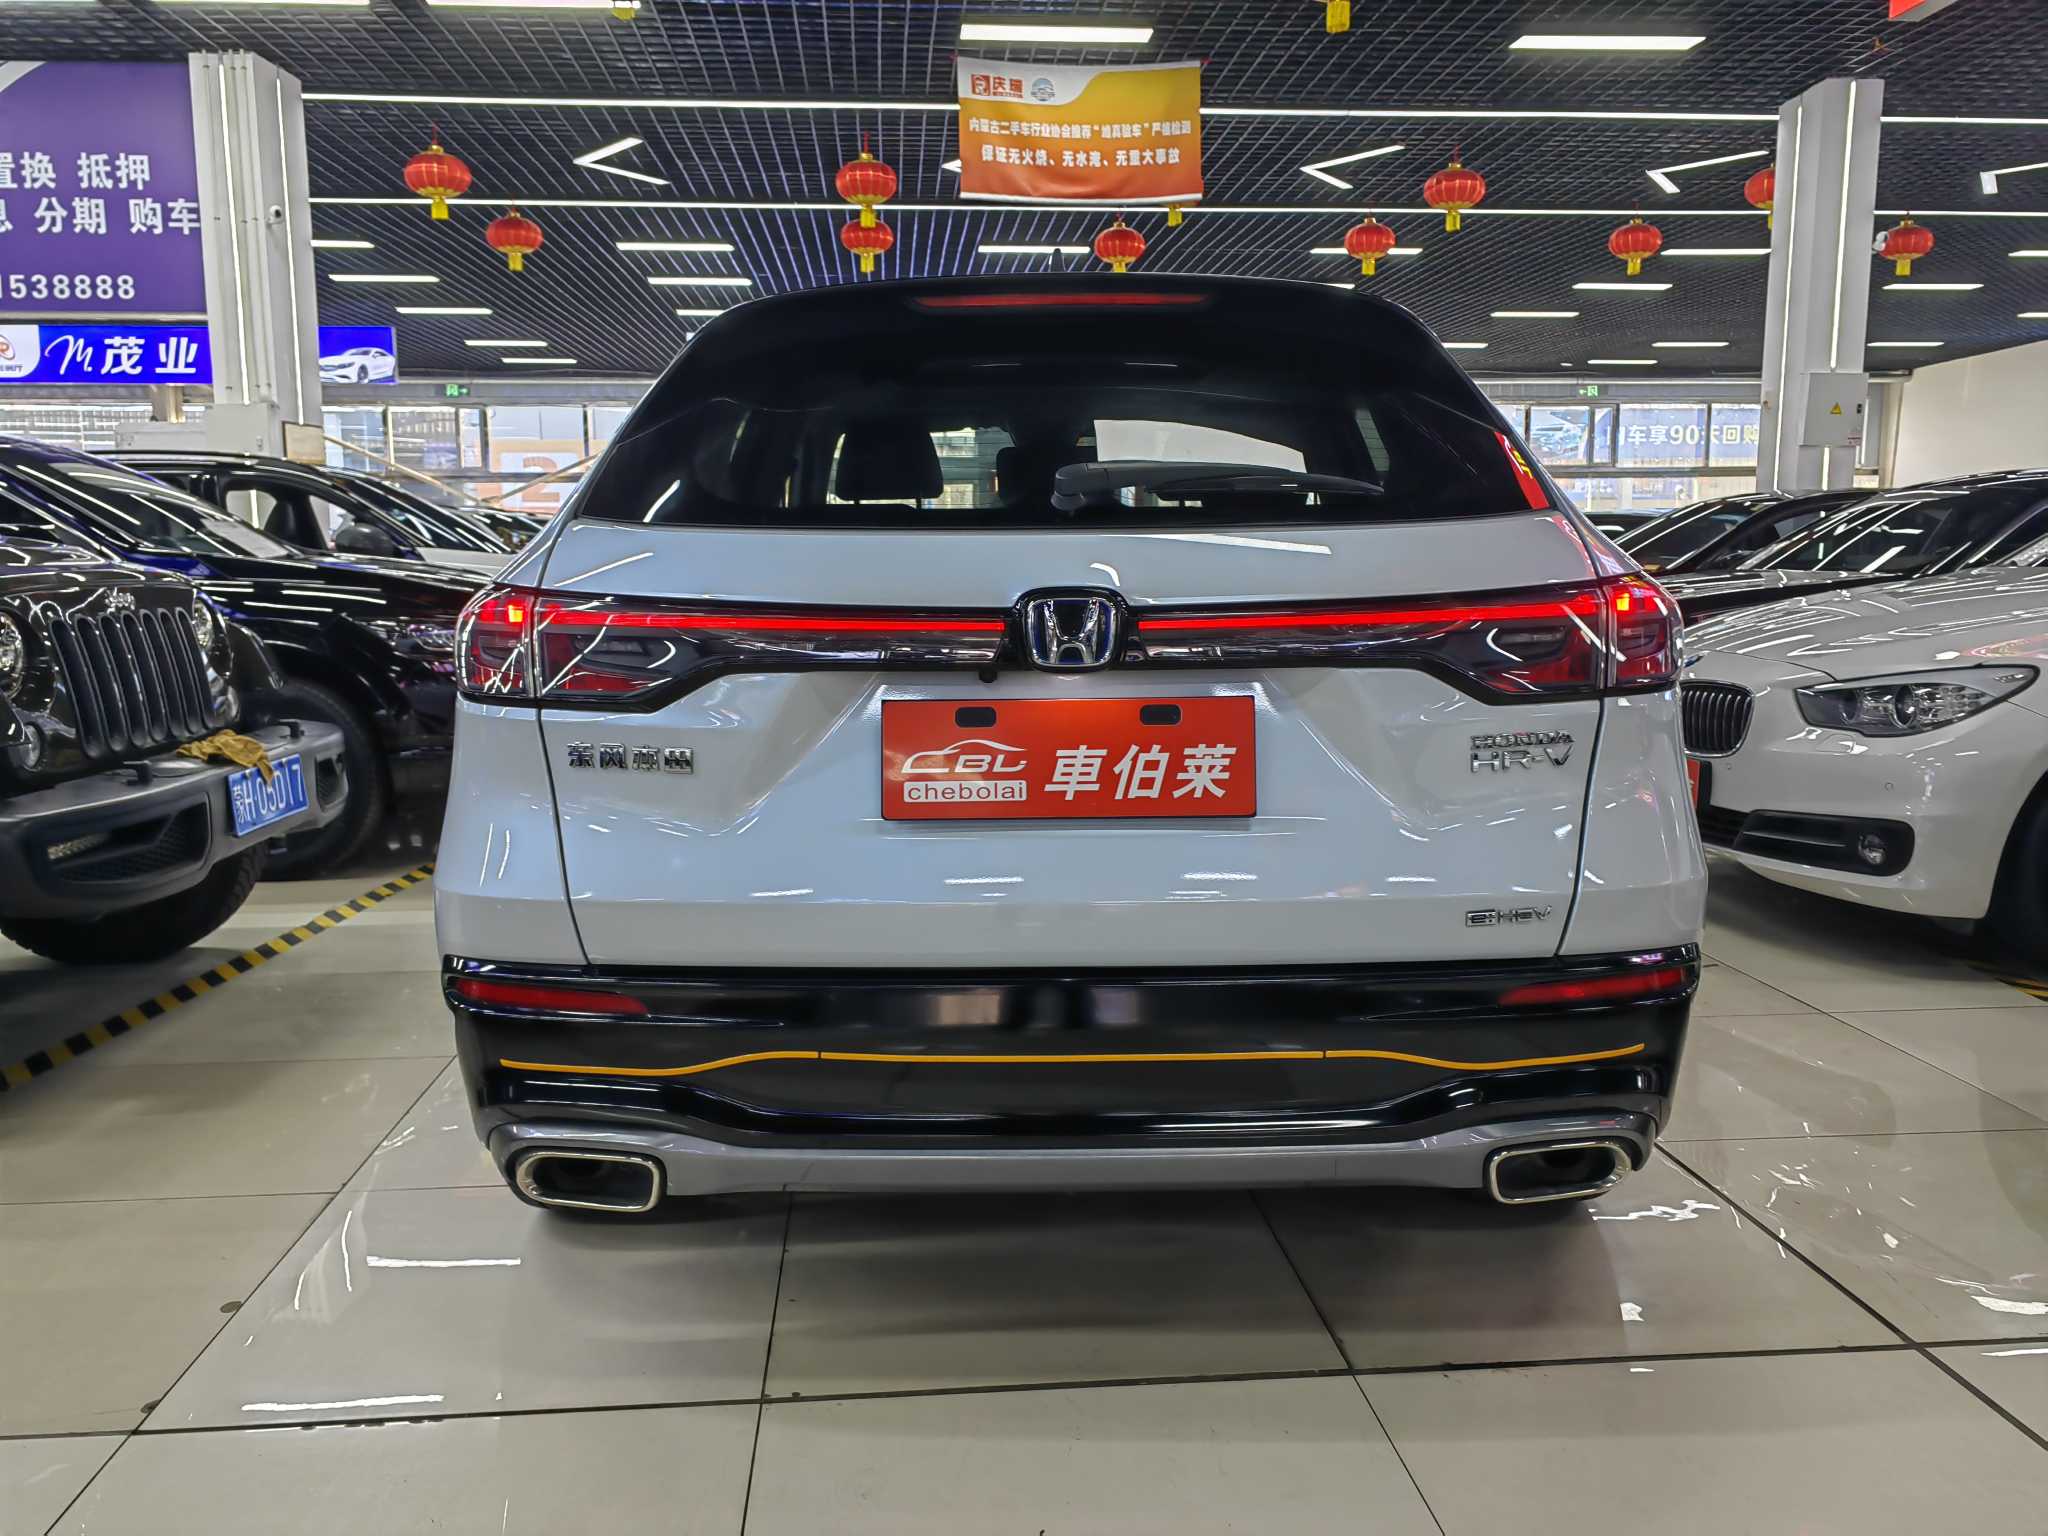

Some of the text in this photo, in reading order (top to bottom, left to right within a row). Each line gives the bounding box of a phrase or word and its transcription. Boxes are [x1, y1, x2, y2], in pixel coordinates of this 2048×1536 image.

[77, 152, 151, 190] 抵押
[34, 197, 107, 234] 分期
[128, 197, 201, 235] 购车
[100, 336, 199, 375] 茂业
[1471, 731, 1574, 750] HONDA
[1471, 745, 1572, 773] HR-V
[907, 780, 1024, 801] chebolai
[1044, 743, 1236, 801] 車伯莱
